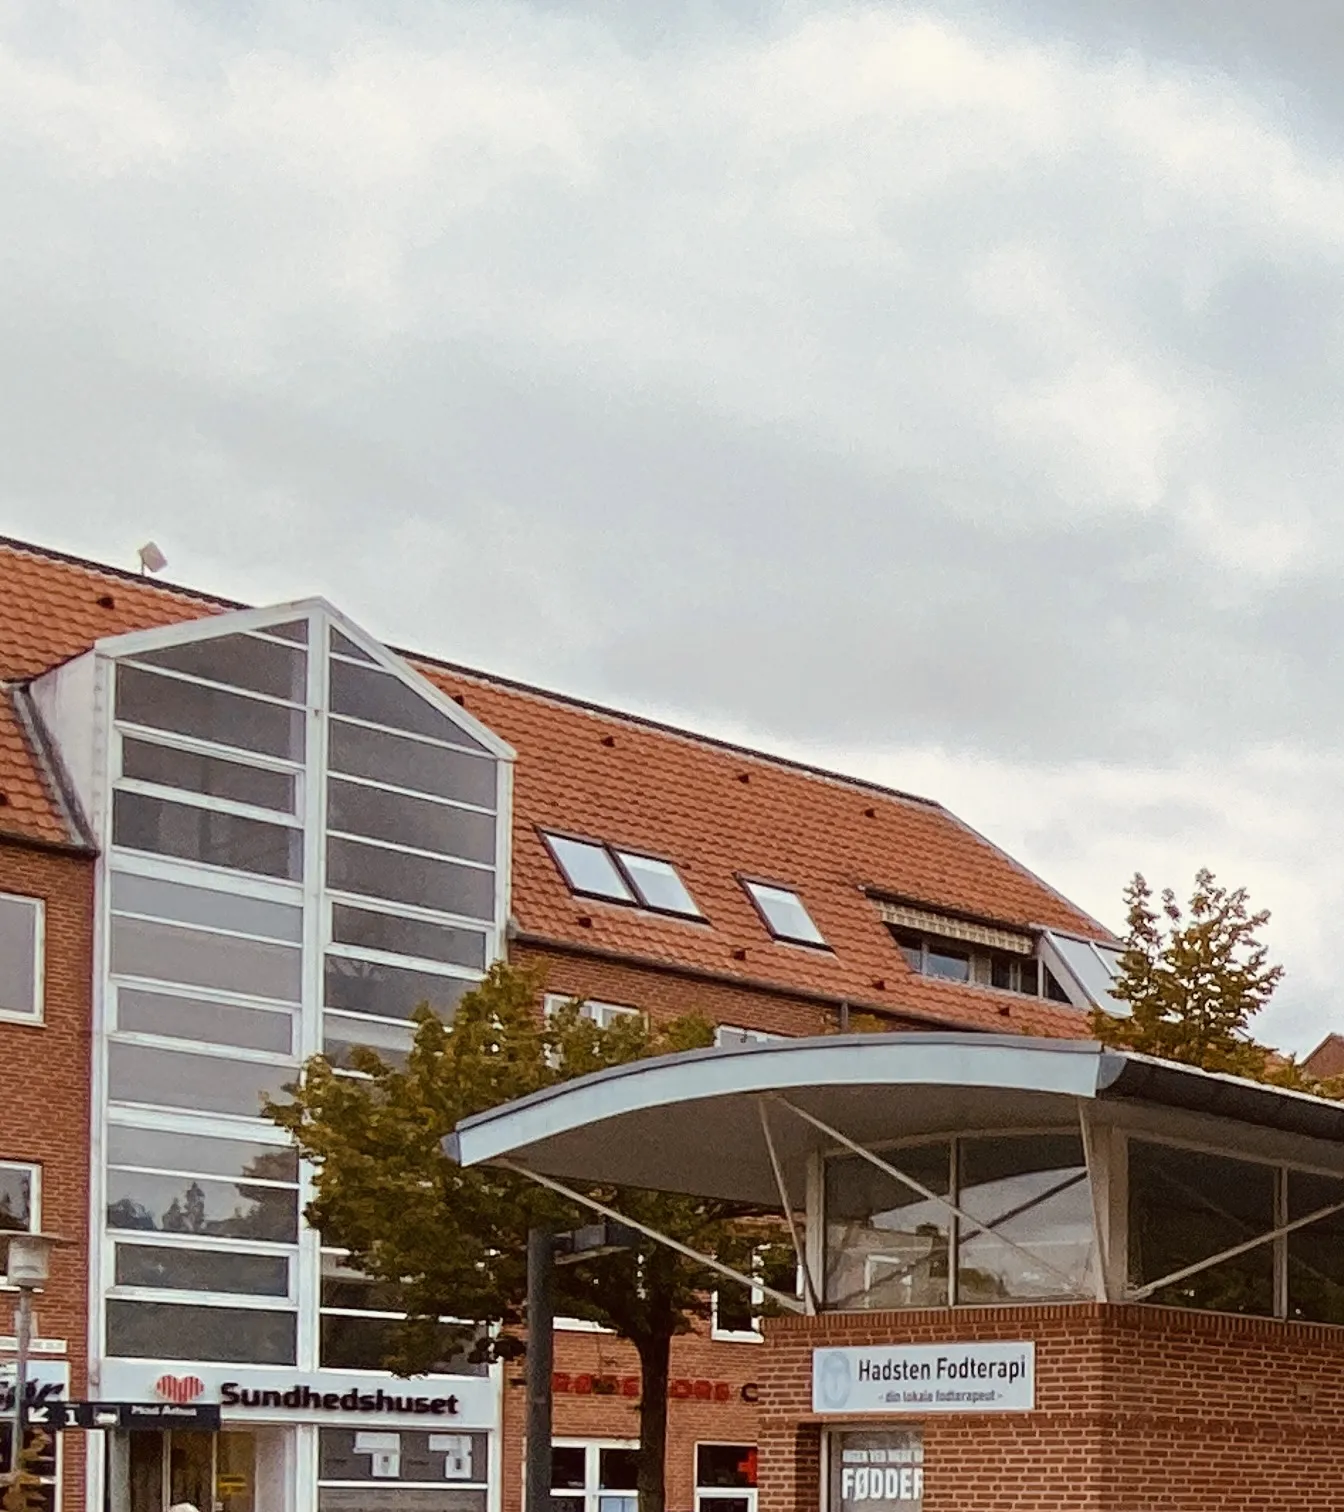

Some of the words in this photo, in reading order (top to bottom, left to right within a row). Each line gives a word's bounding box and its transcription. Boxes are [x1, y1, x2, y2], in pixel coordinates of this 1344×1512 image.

[858, 1358, 931, 1382] Hadsten
[936, 1354, 1026, 1384] Fodterapi
[220, 1382, 459, 1415] Sundhedshuset
